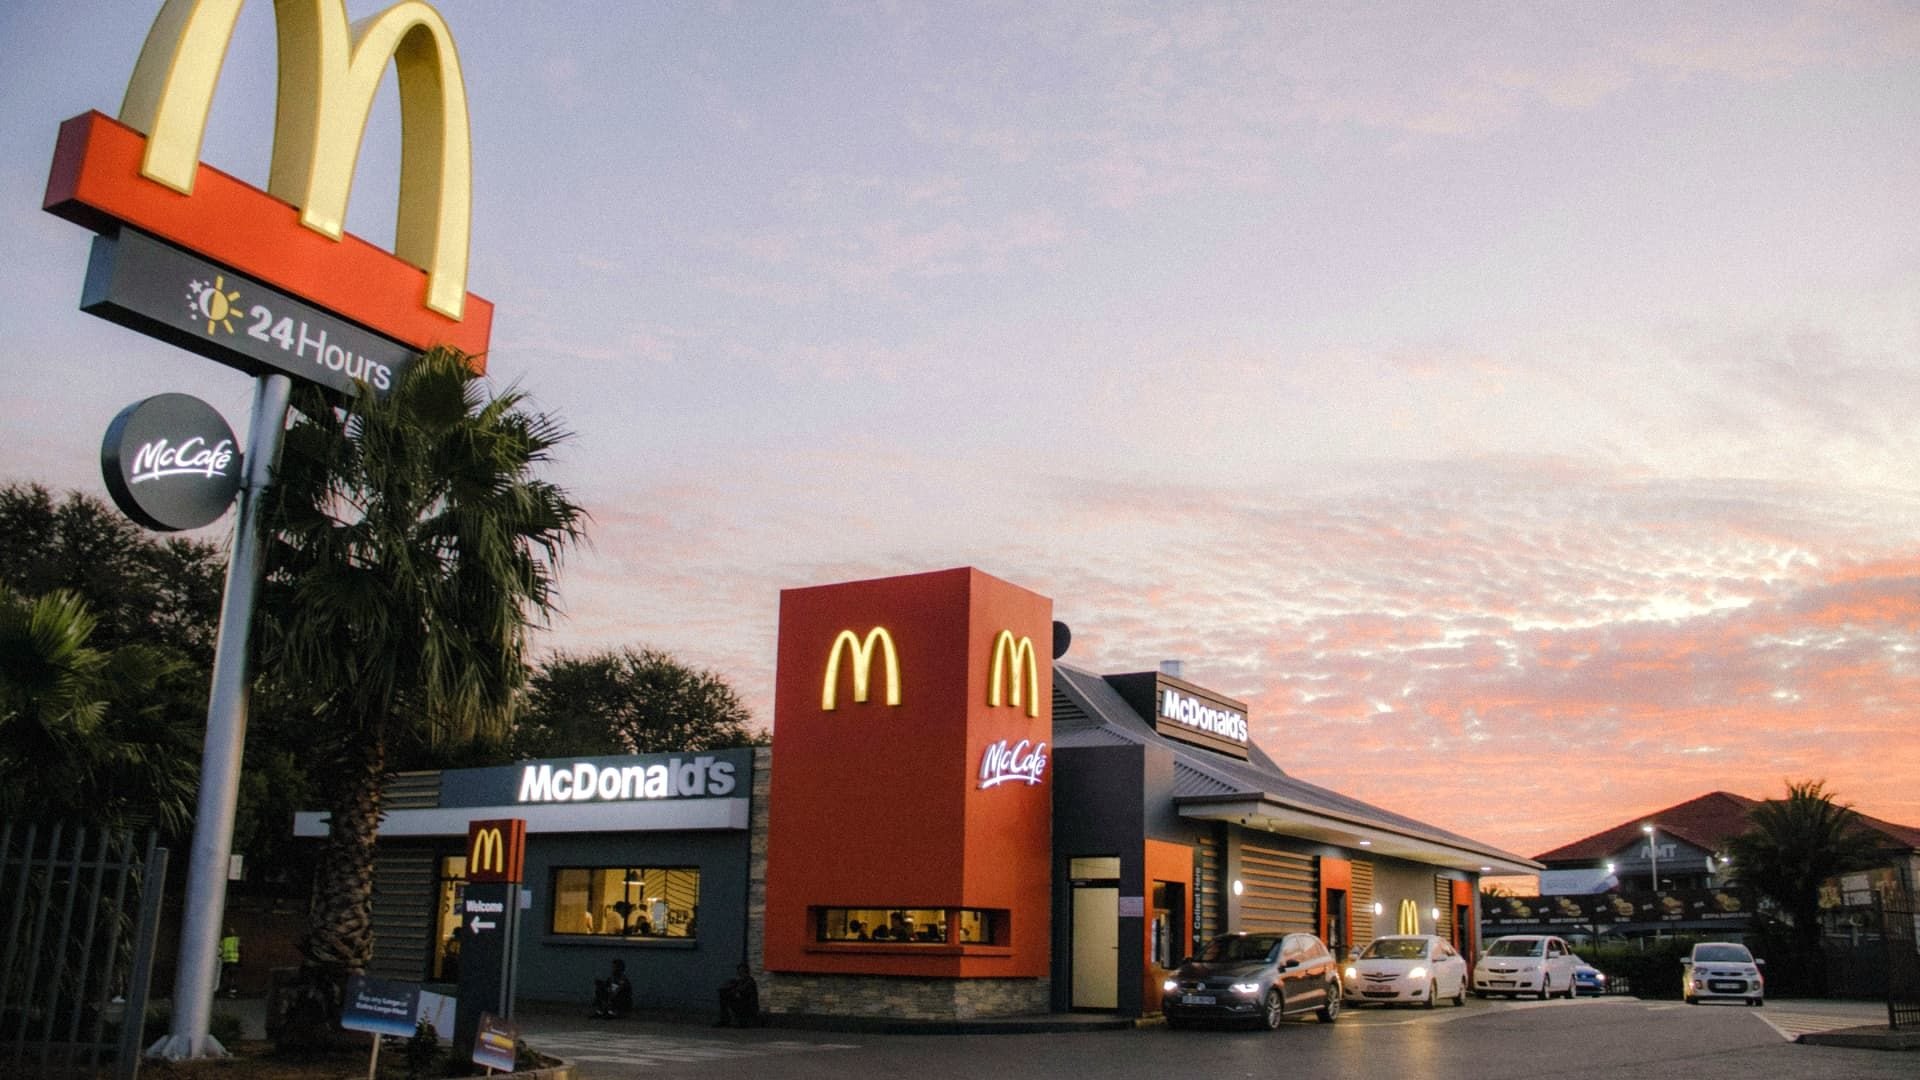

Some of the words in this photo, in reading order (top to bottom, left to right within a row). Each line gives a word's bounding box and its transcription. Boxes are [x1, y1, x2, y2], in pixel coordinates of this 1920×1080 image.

[296, 321, 392, 390] Hours
[131, 436, 233, 483] McCafé
[1162, 689, 1248, 742] McDonald's
[518, 756, 737, 801] McDonald's
[979, 739, 1047, 789] McCafé
